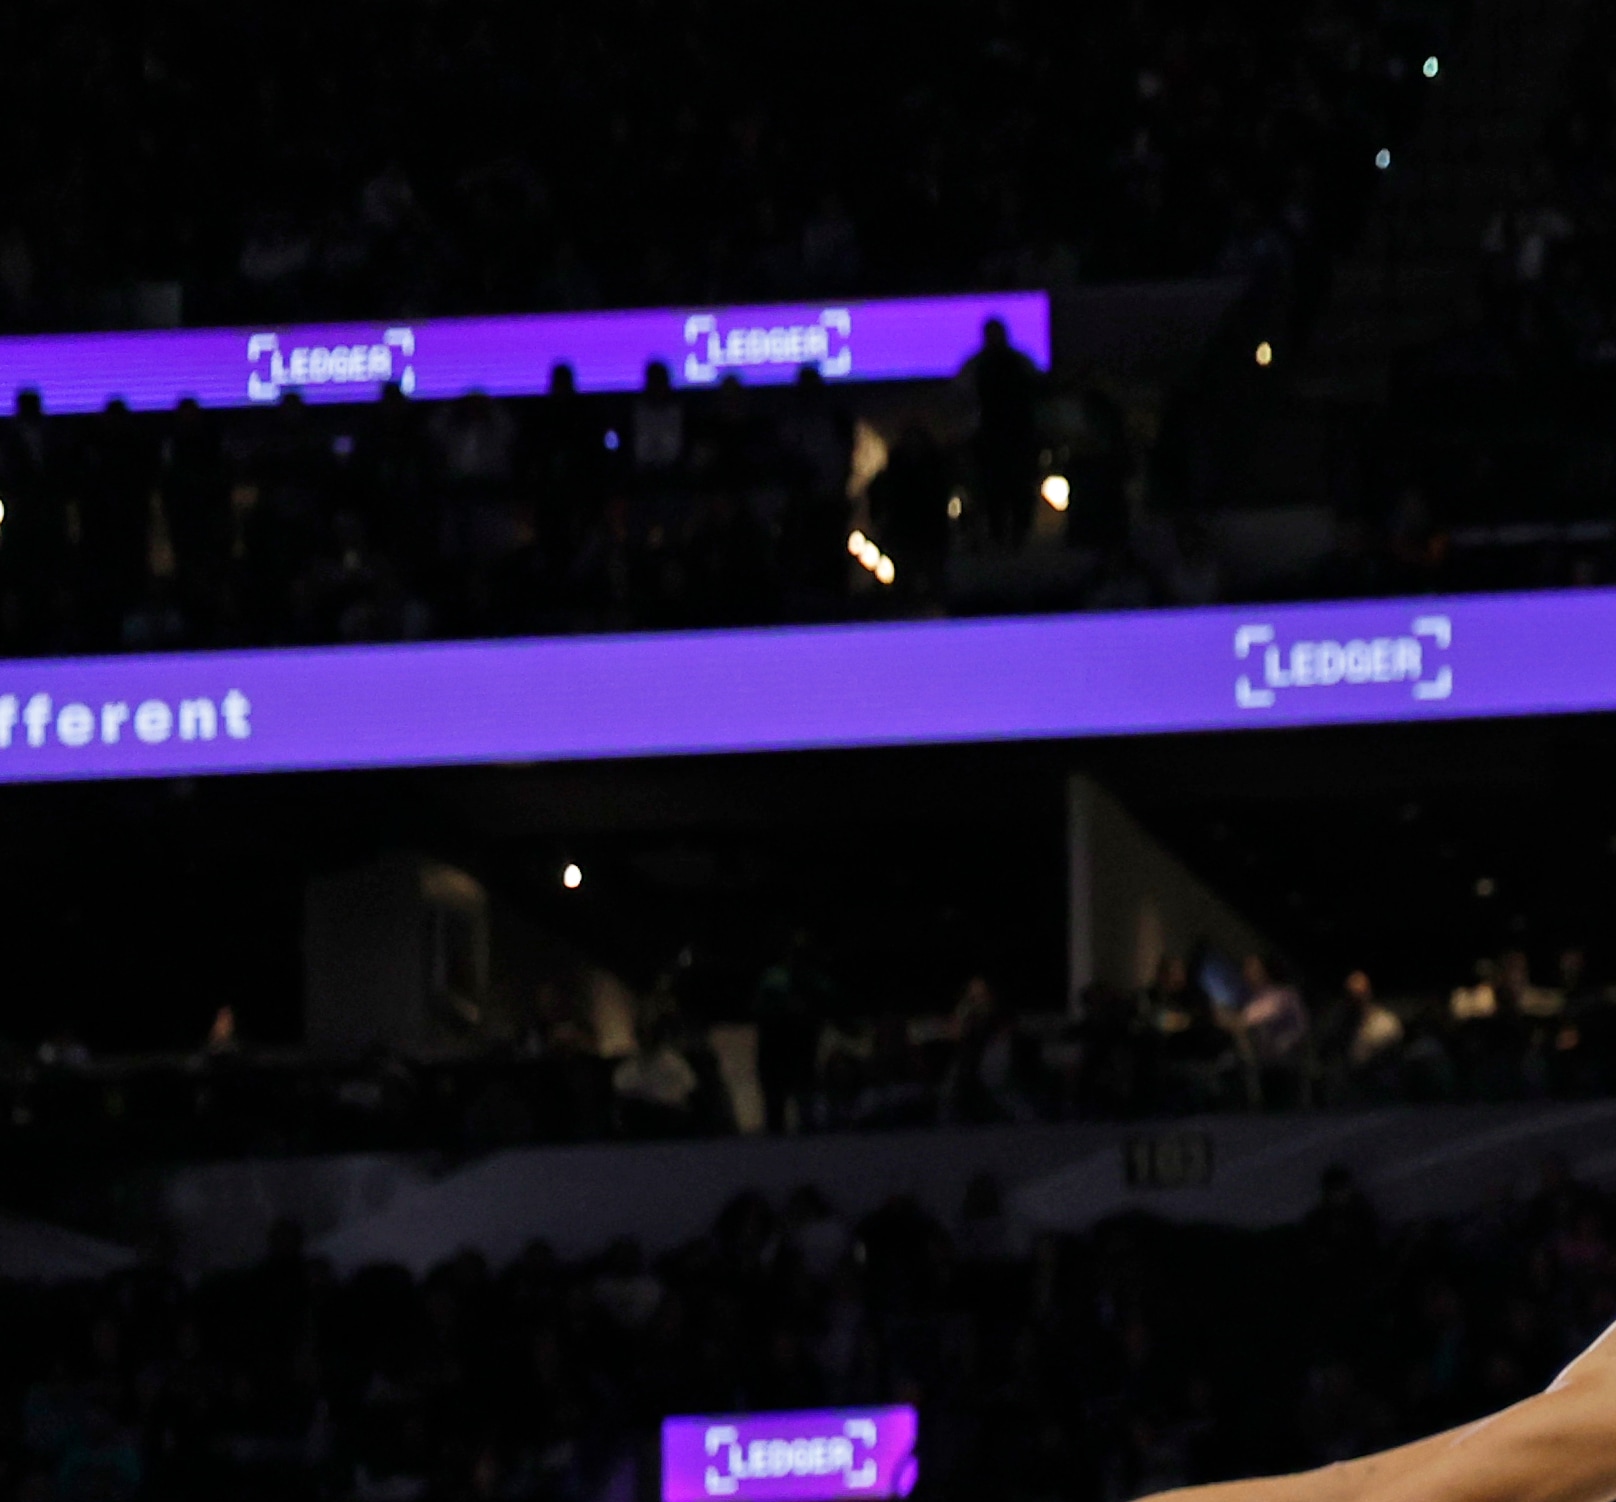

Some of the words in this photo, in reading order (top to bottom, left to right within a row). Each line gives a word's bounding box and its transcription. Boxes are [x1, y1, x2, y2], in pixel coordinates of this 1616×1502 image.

[270, 344, 392, 386] LEDGER
[707, 323, 829, 367] LEDGER
[1264, 637, 1422, 687] LEDGER
[729, 1436, 854, 1480] LEDGER
